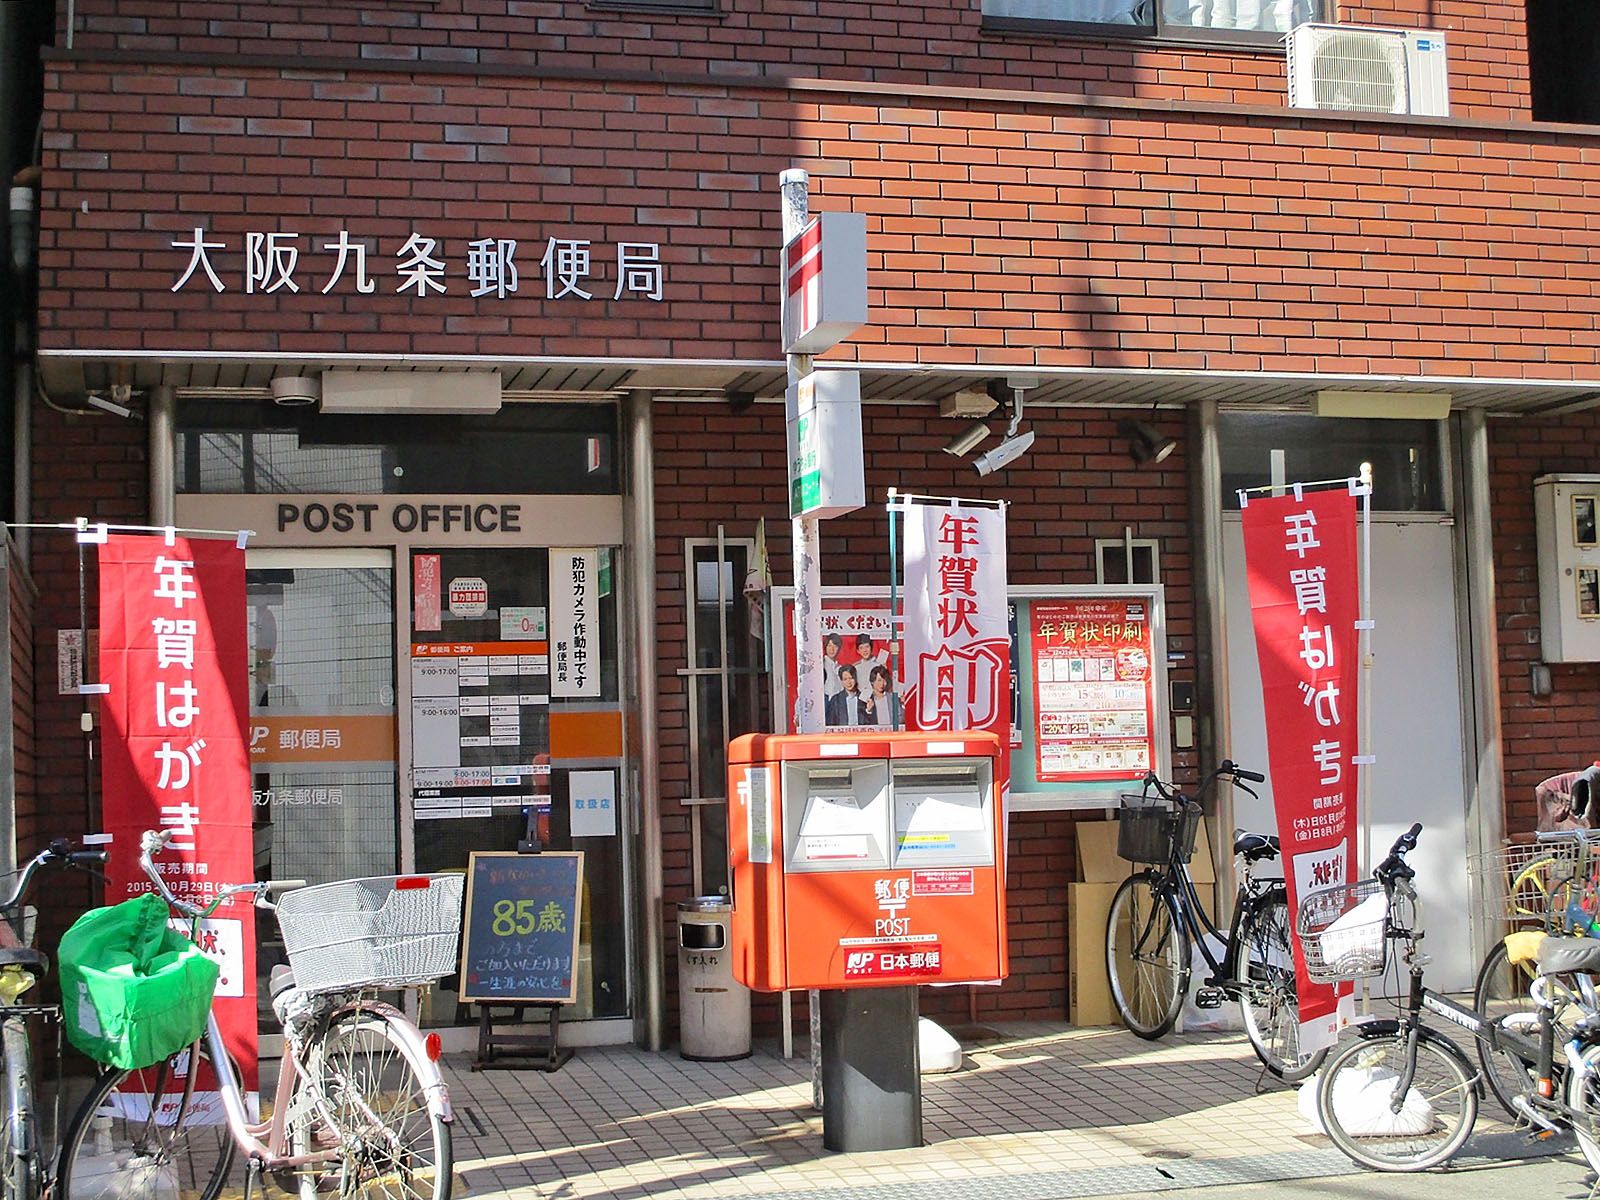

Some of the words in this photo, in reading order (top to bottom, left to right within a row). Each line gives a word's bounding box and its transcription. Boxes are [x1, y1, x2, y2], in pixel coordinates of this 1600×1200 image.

[171, 228, 664, 301] 大阪九条郵便局
[278, 503, 378, 532] POST
[392, 503, 521, 532] OFFICE
[572, 557, 587, 688] 防犯カメラ作動中です
[1037, 620, 1142, 644] 年賀状印刷
[557, 641, 568, 682] 郵便局長
[152, 556, 206, 851] 年賀はがき
[280, 729, 341, 749] 郵便局
[874, 878, 910, 900] 郵便
[492, 899, 566, 936] 85歳
[876, 918, 910, 936] POST
[880, 952, 940, 971] 日本郵便
